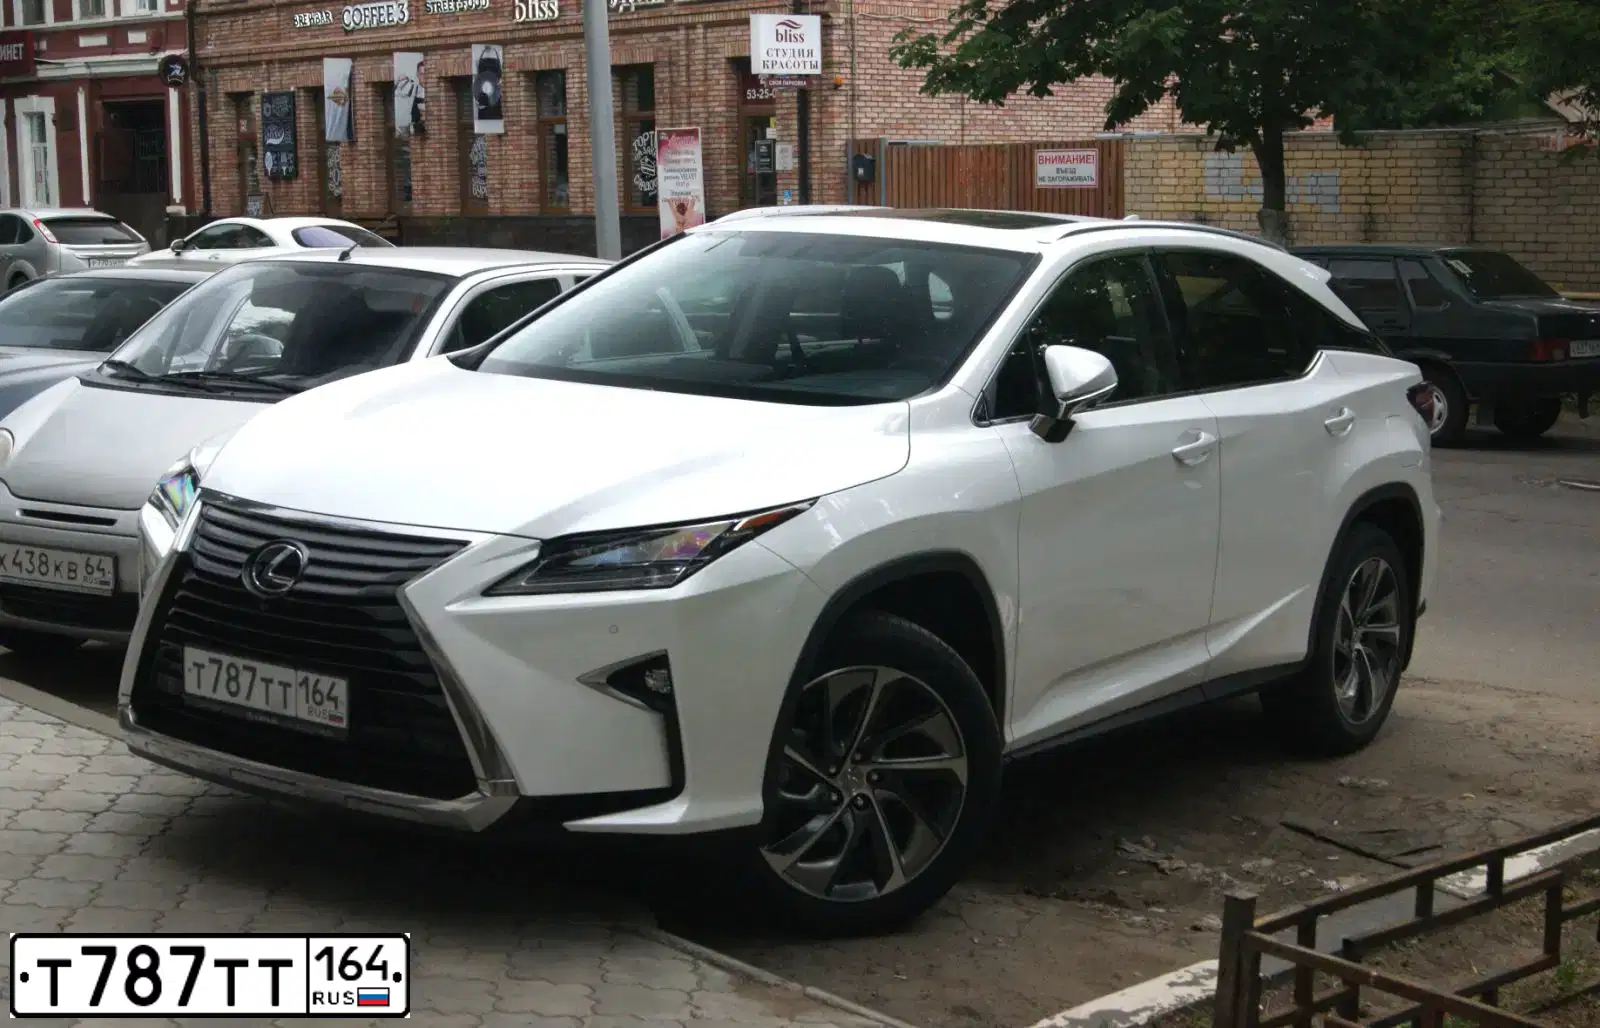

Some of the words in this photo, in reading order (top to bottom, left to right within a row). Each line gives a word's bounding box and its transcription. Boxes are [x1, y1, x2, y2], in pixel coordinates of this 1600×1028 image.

[342, 4, 395, 30] COFFEE
[775, 29, 805, 43] bliss
[766, 48, 814, 58] СТУДИЯ
[762, 59, 819, 70] КРАСОТЫ
[1038, 154, 1095, 165] ВНИМАНИЕ!
[84, 556, 106, 577] 64
[192, 657, 292, 710] Т787ТТ
[299, 675, 339, 710] 164
[307, 705, 328, 721] RUS
